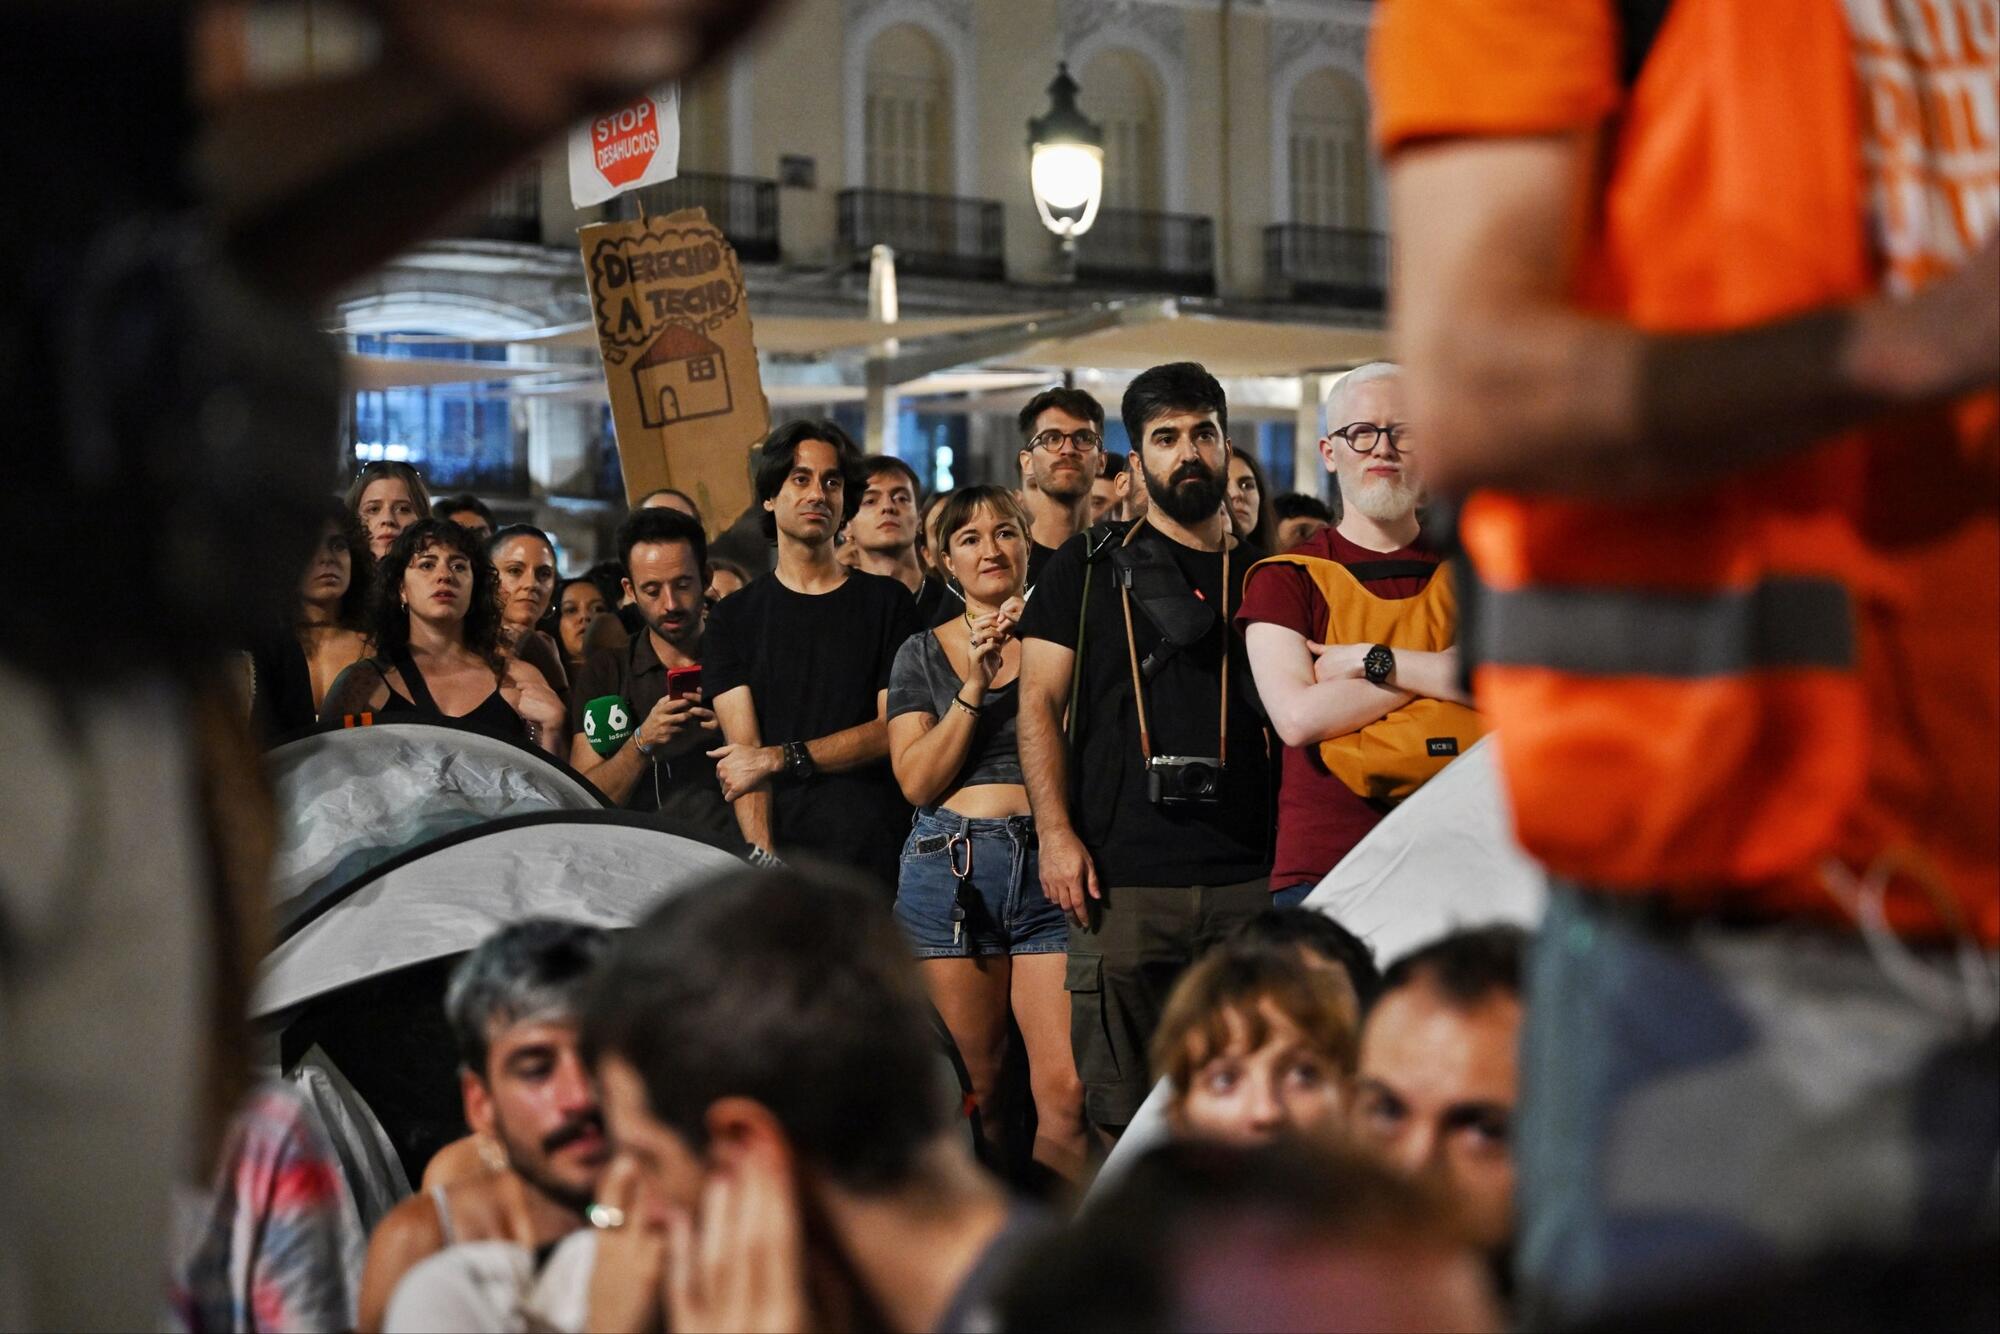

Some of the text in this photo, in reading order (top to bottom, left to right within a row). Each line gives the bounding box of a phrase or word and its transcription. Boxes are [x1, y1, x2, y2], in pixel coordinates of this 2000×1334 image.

[596, 103, 650, 142] STOP
[598, 130, 658, 170] DESAHUCIOS
[603, 241, 721, 289] DERECHO
[618, 279, 732, 333] A TECHO
